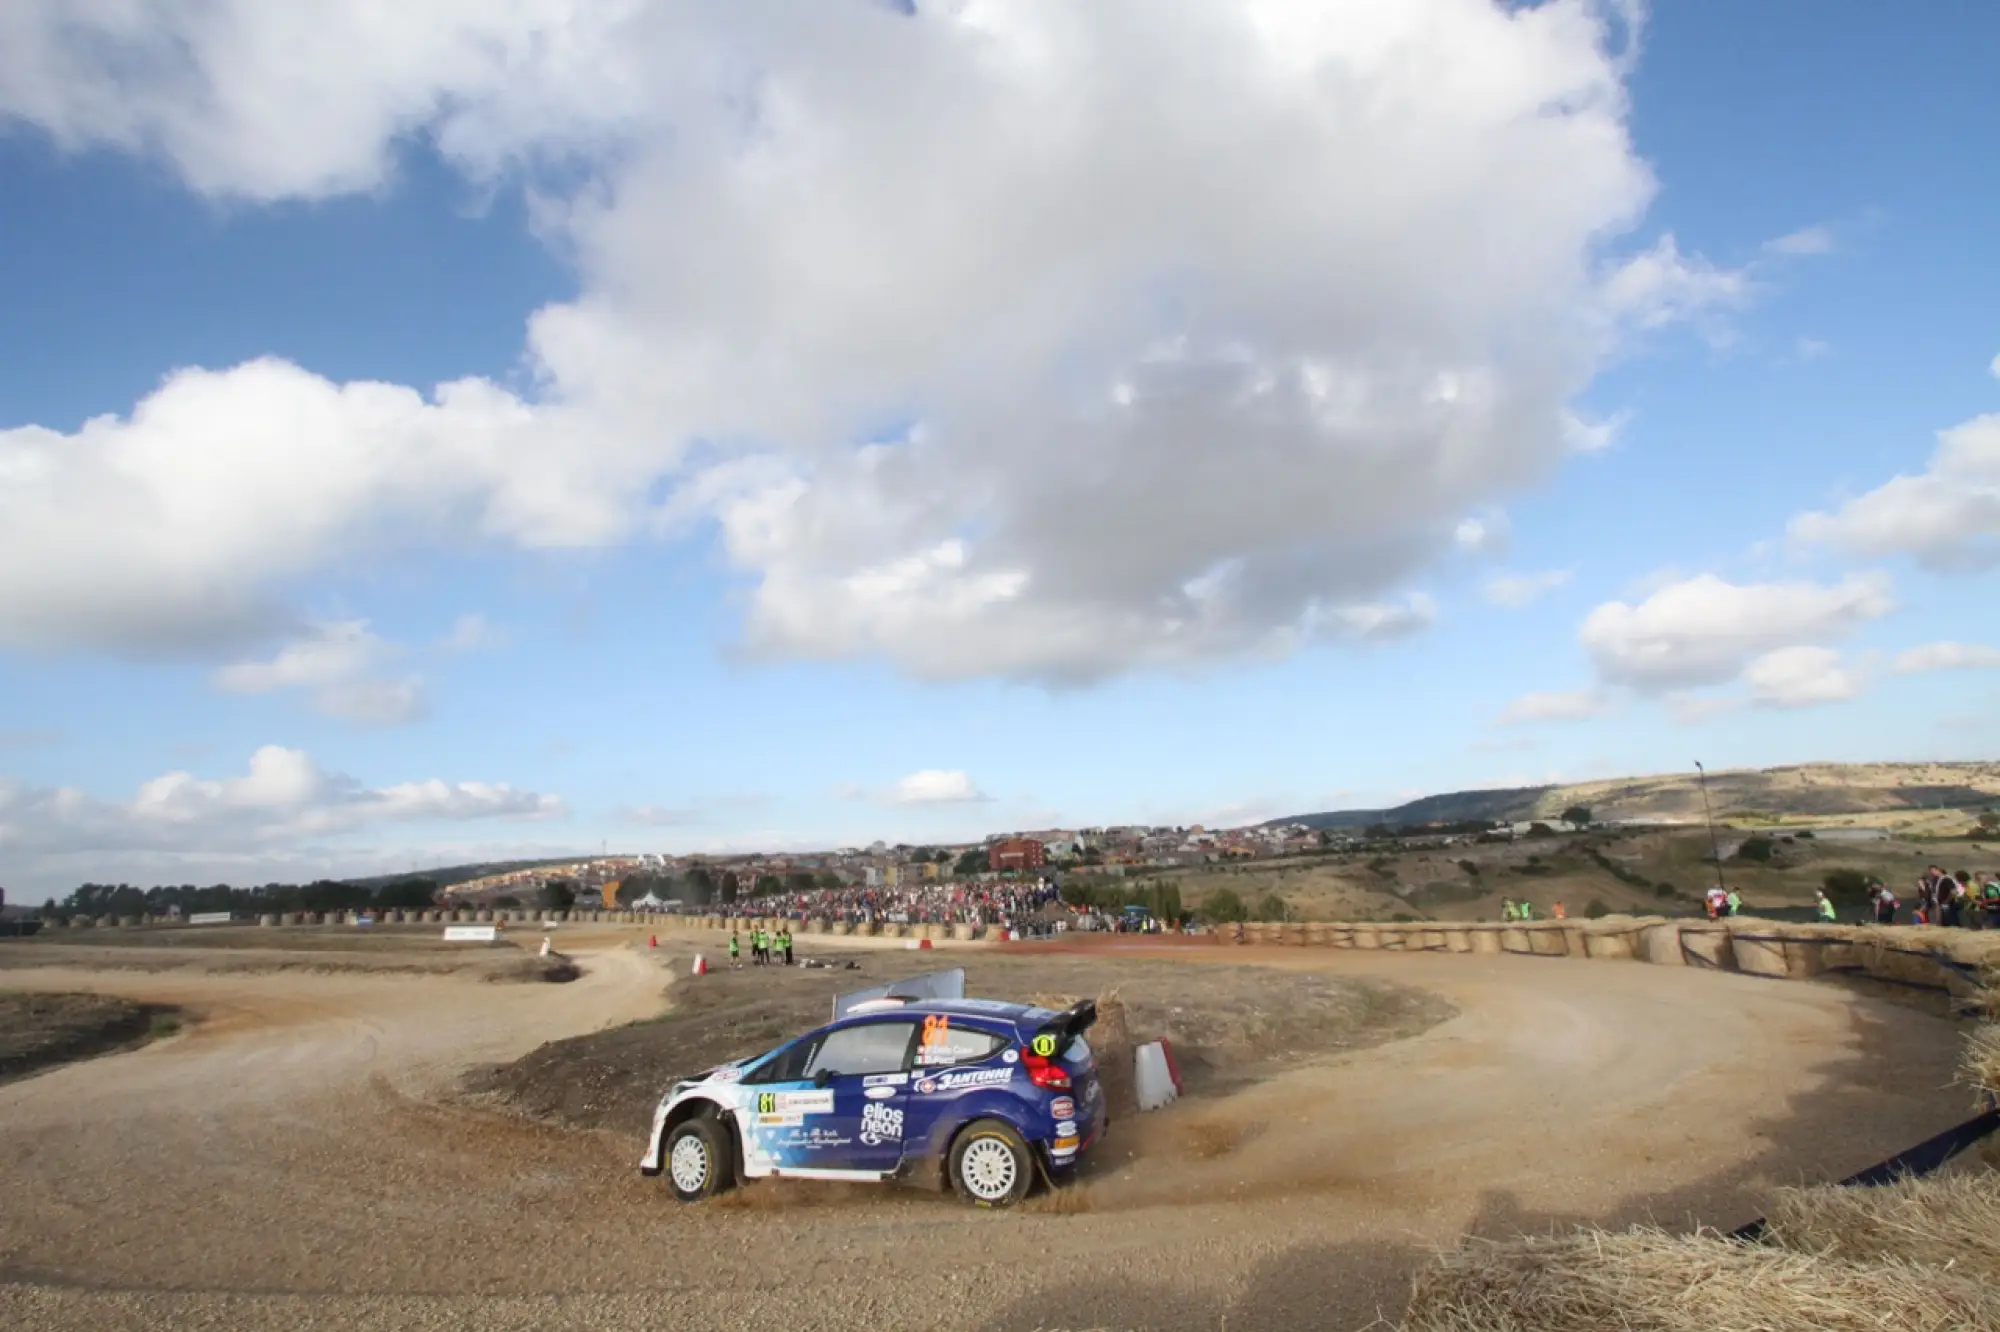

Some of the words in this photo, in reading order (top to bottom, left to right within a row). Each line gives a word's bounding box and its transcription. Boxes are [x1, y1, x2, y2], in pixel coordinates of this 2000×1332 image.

[922, 1014, 949, 1048] 81
[759, 1093, 774, 1112] 81
[863, 1101, 904, 1124] elios
[860, 1117, 903, 1138] neon
